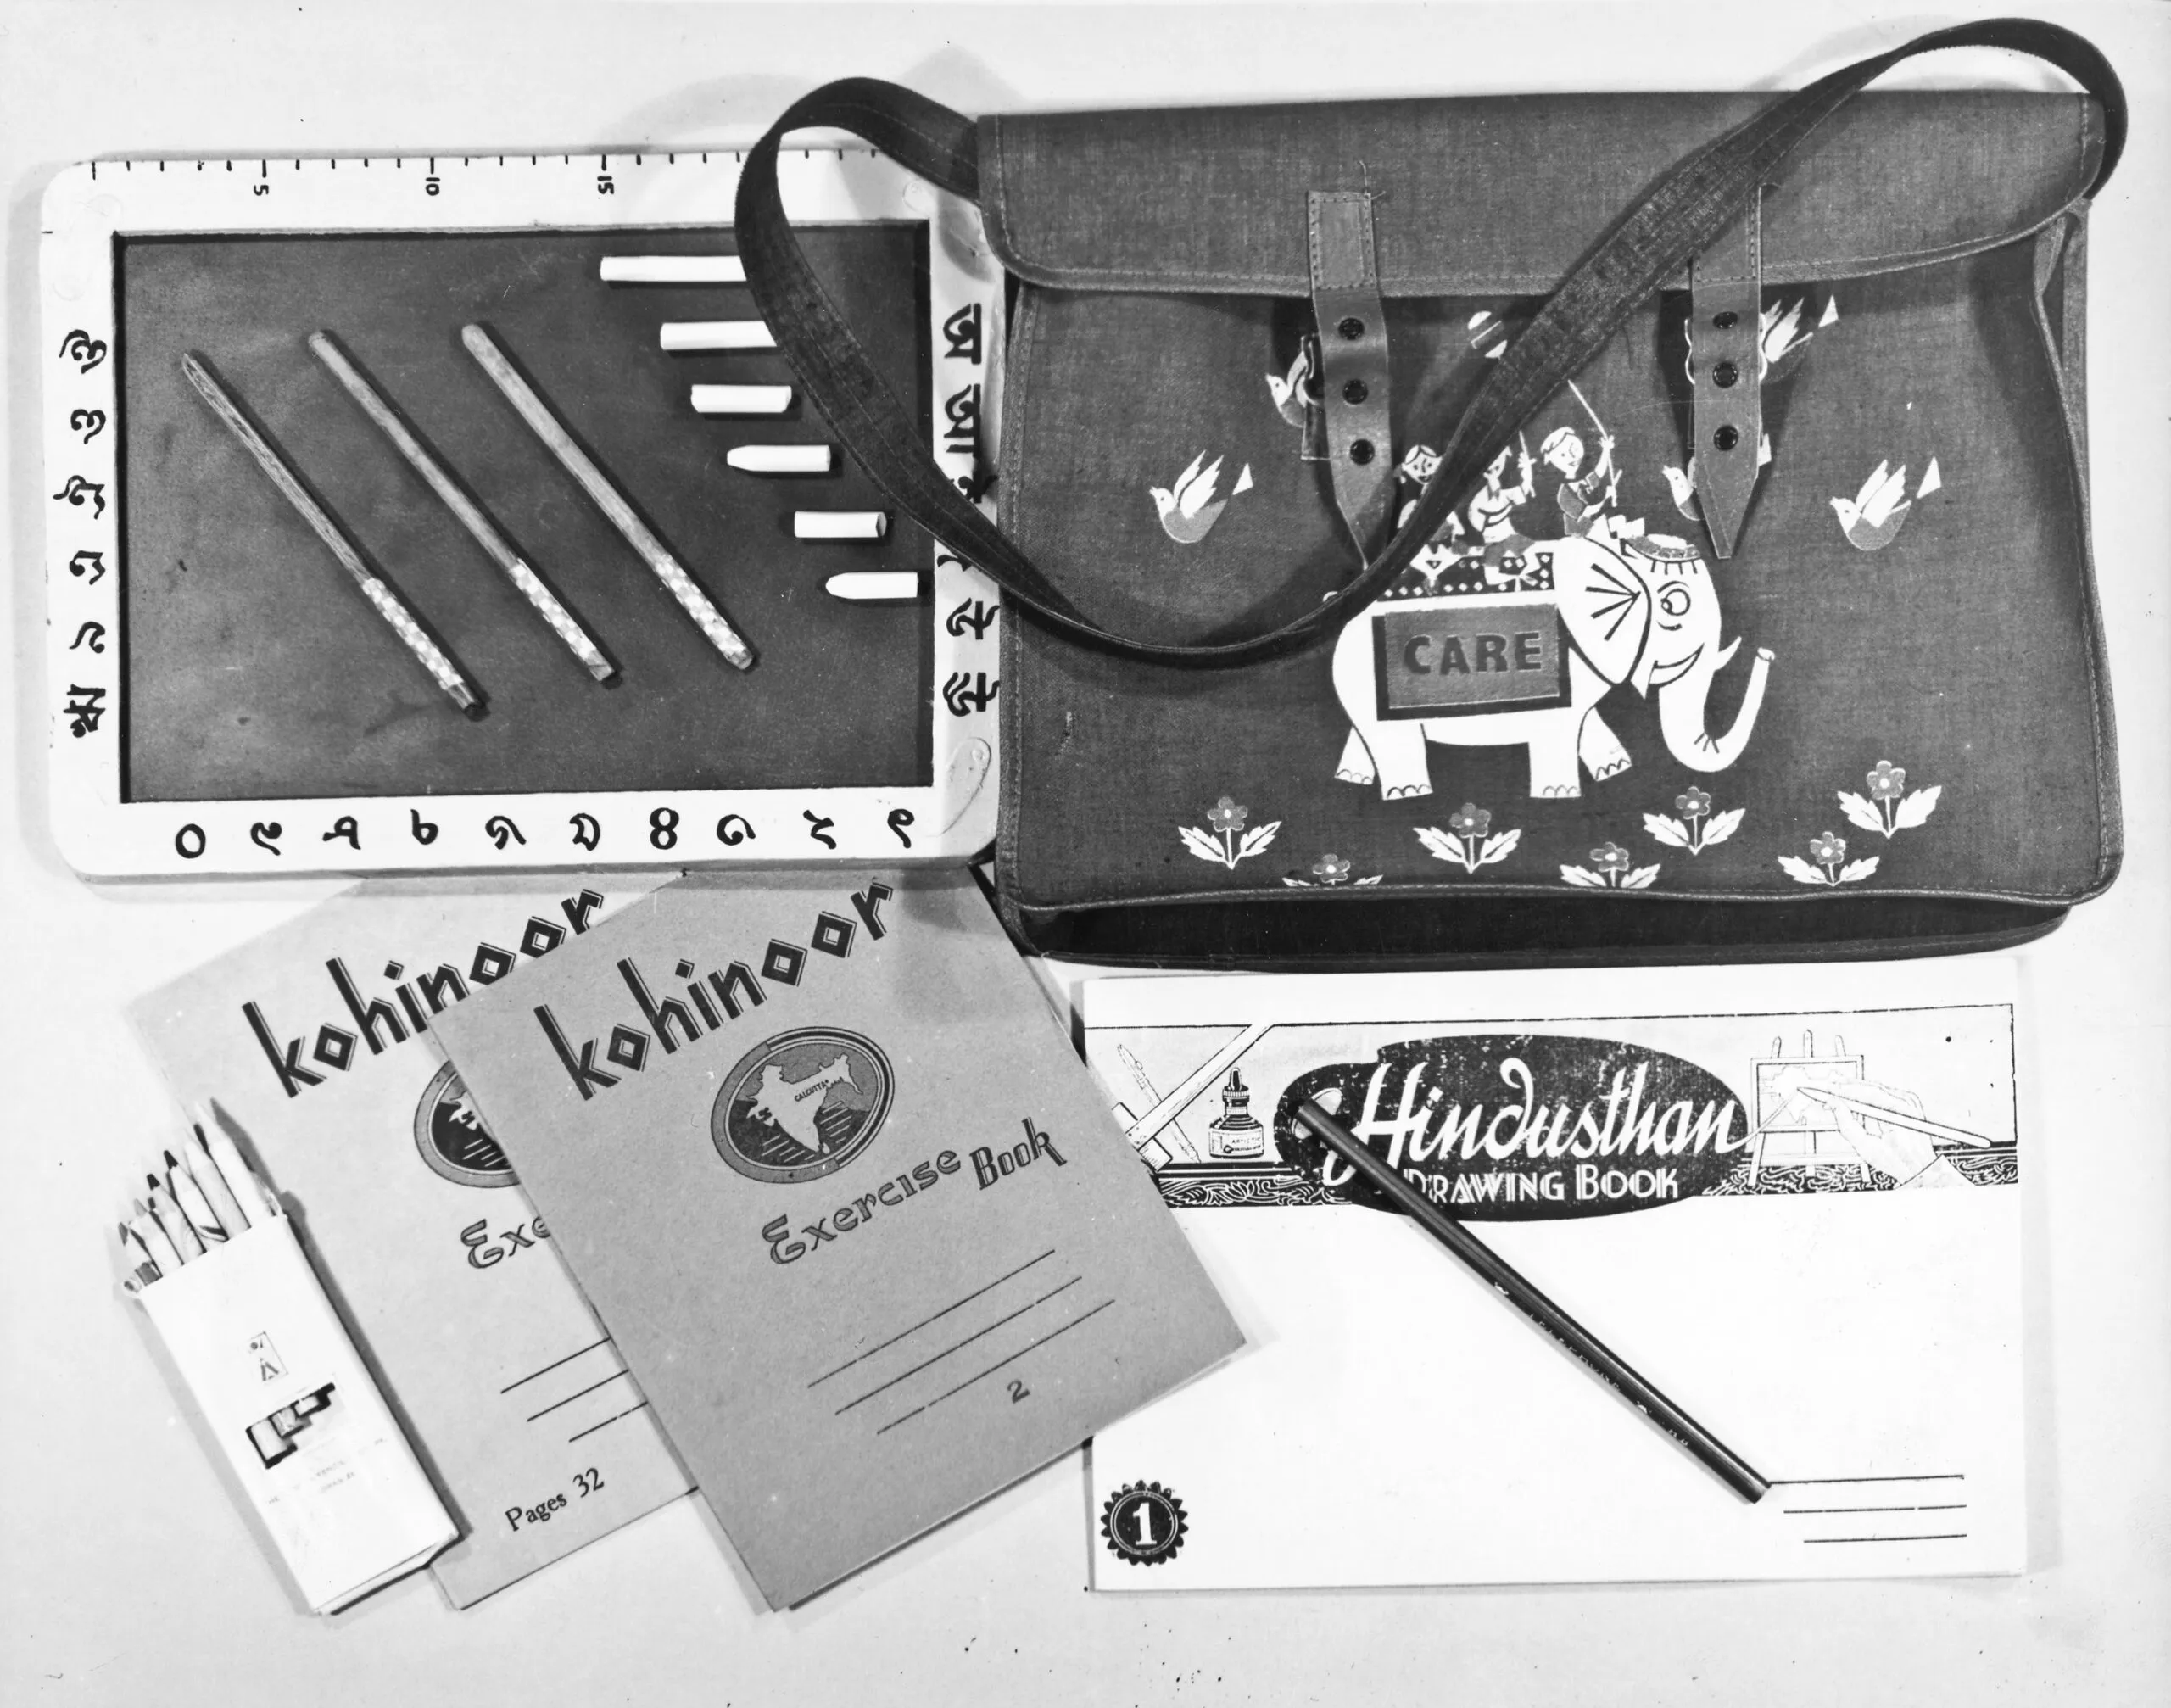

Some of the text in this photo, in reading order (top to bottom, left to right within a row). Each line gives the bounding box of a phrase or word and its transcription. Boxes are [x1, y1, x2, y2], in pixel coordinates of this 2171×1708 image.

[254, 184, 270, 197] 5
[426, 176, 441, 197] 10
[597, 175, 615, 195] 15
[59, 329, 107, 374] ঔ
[943, 303, 982, 365] অ
[70, 409, 107, 445] ও
[944, 383, 983, 454] আ
[53, 475, 106, 520] ঐ
[69, 550, 106, 585] এ
[946, 598, 999, 639] উ
[1404, 631, 1543, 678] CARE
[943, 672, 1000, 717] ঊ
[250, 822, 282, 857] ৯
[322, 815, 361, 851] ৮
[410, 809, 439, 846] ৭
[485, 815, 527, 850] ৬
[569, 812, 601, 851] ৫
[717, 813, 756, 846] ৩
[802, 809, 838, 850] ২
[887, 808, 915, 849] ১
[533, 882, 894, 1101] kohinoor
[794, 1081, 827, 1102] CALCUTTA
[1322, 1057, 1749, 1186] Hindusthan
[762, 1116, 1068, 1265] Exercise Book
[1007, 1379, 1031, 1404] 2
[505, 1468, 605, 1532] Pages 32
[1132, 1501, 1158, 1546] 1
